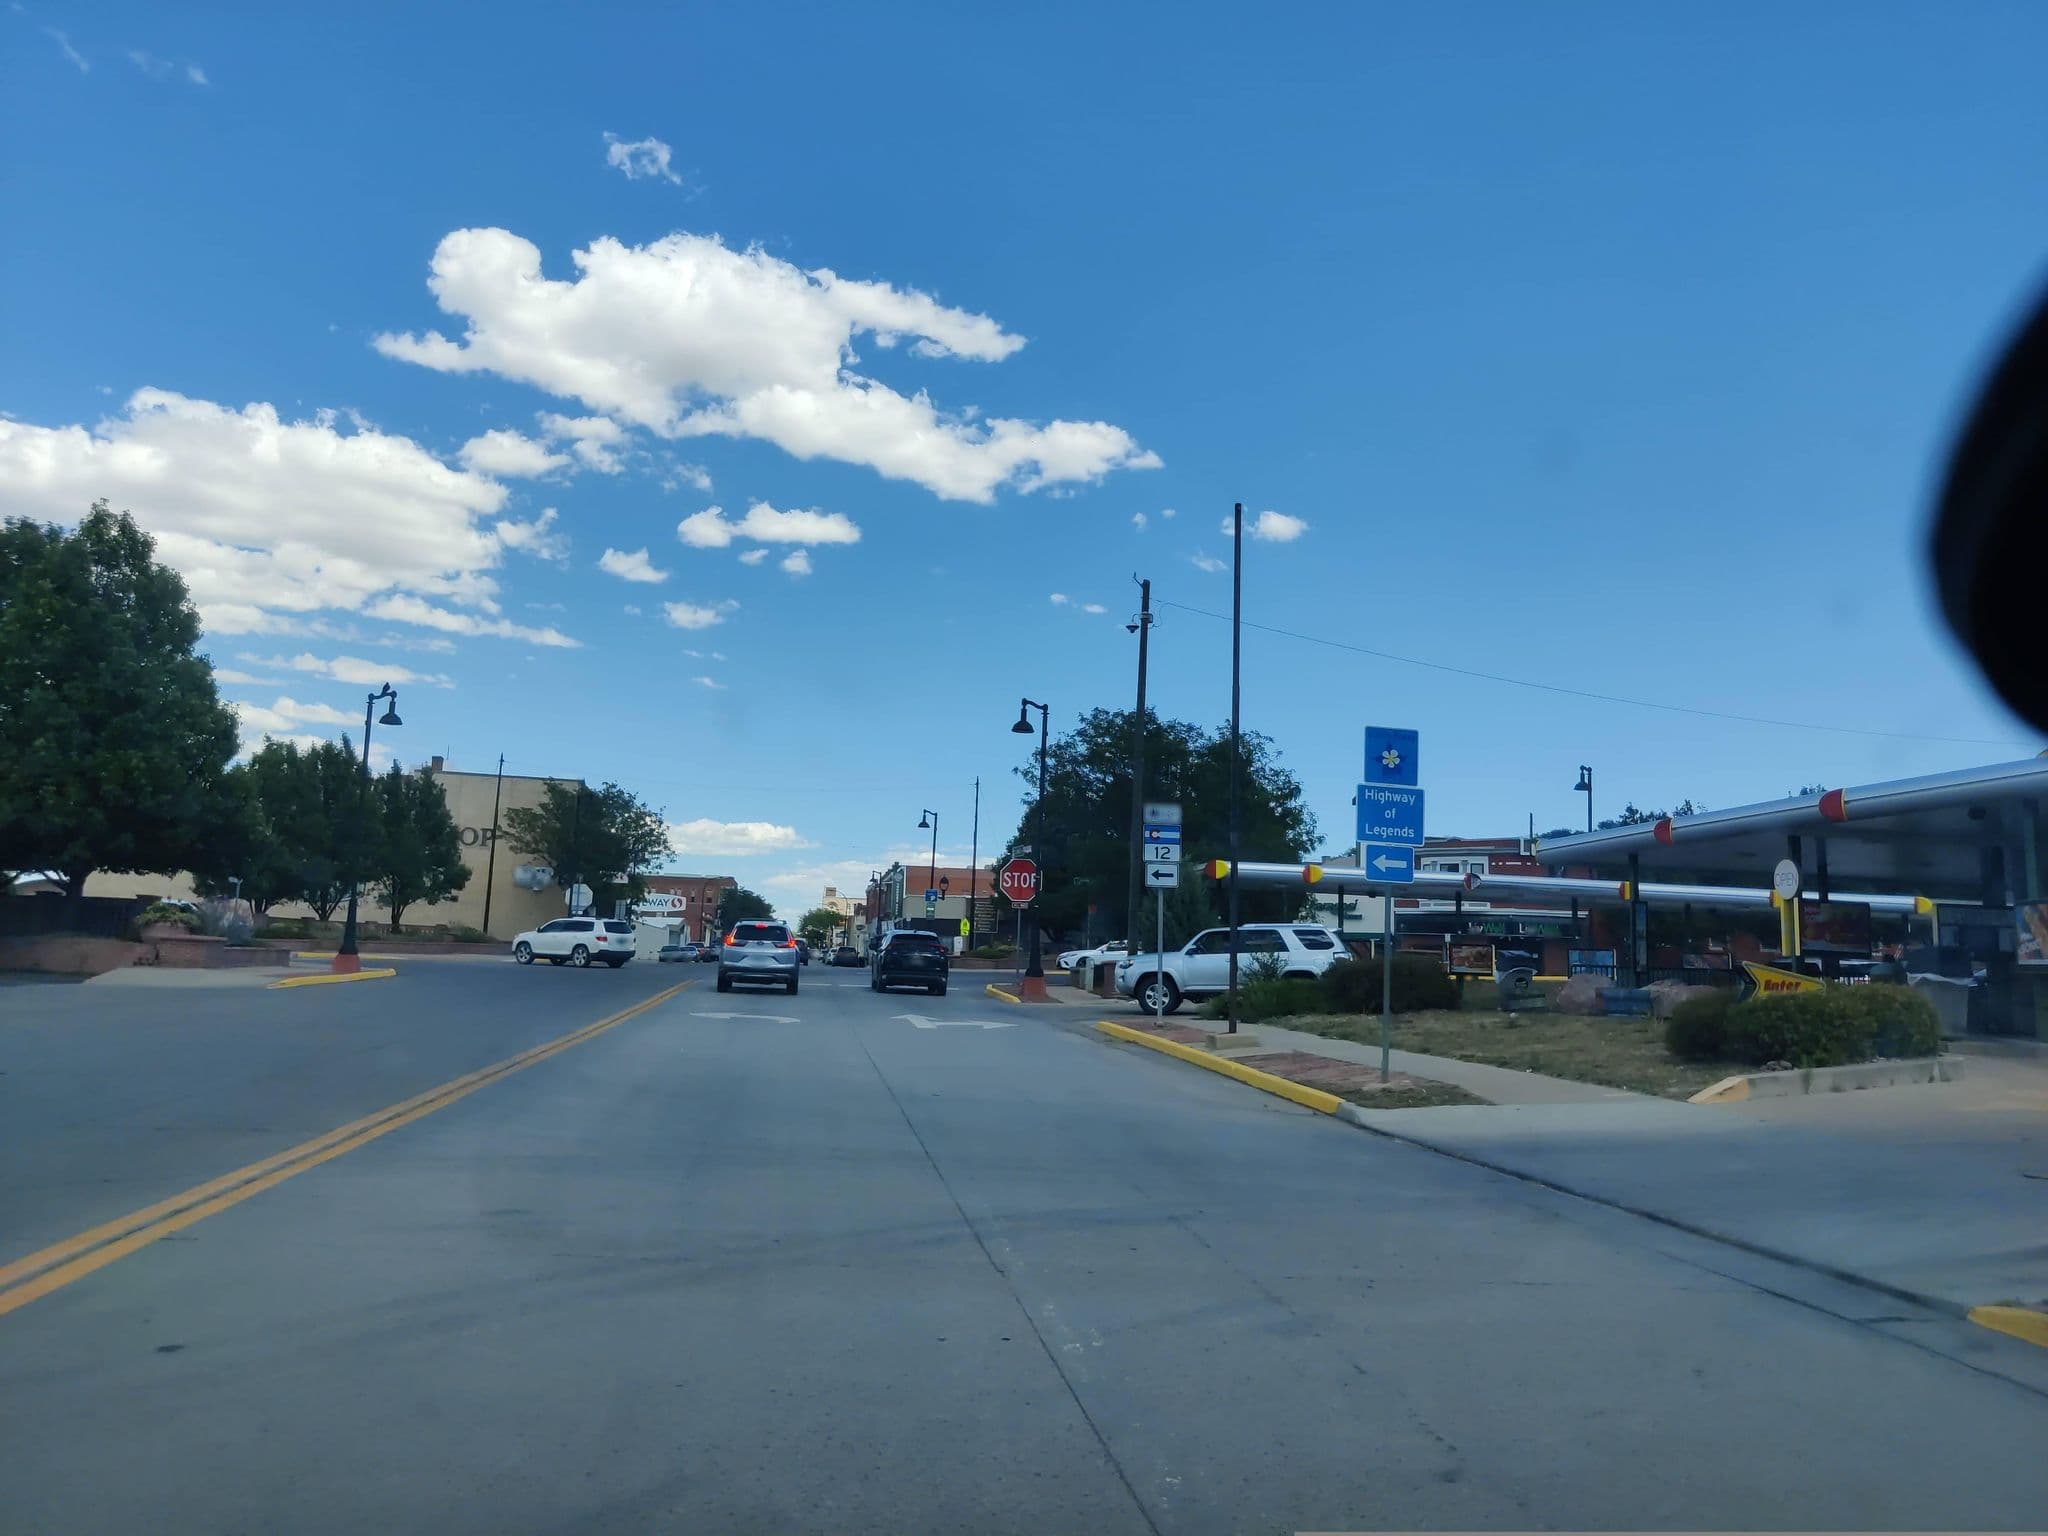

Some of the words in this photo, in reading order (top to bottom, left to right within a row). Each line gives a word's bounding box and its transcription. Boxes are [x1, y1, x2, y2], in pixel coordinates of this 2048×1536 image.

[1365, 788, 1416, 806] Highway
[1384, 807, 1396, 819] of
[1365, 823, 1415, 839] Legends
[1154, 846, 1171, 860] 12
[1003, 871, 1038, 888] STOP
[1763, 978, 1802, 992] Enter
